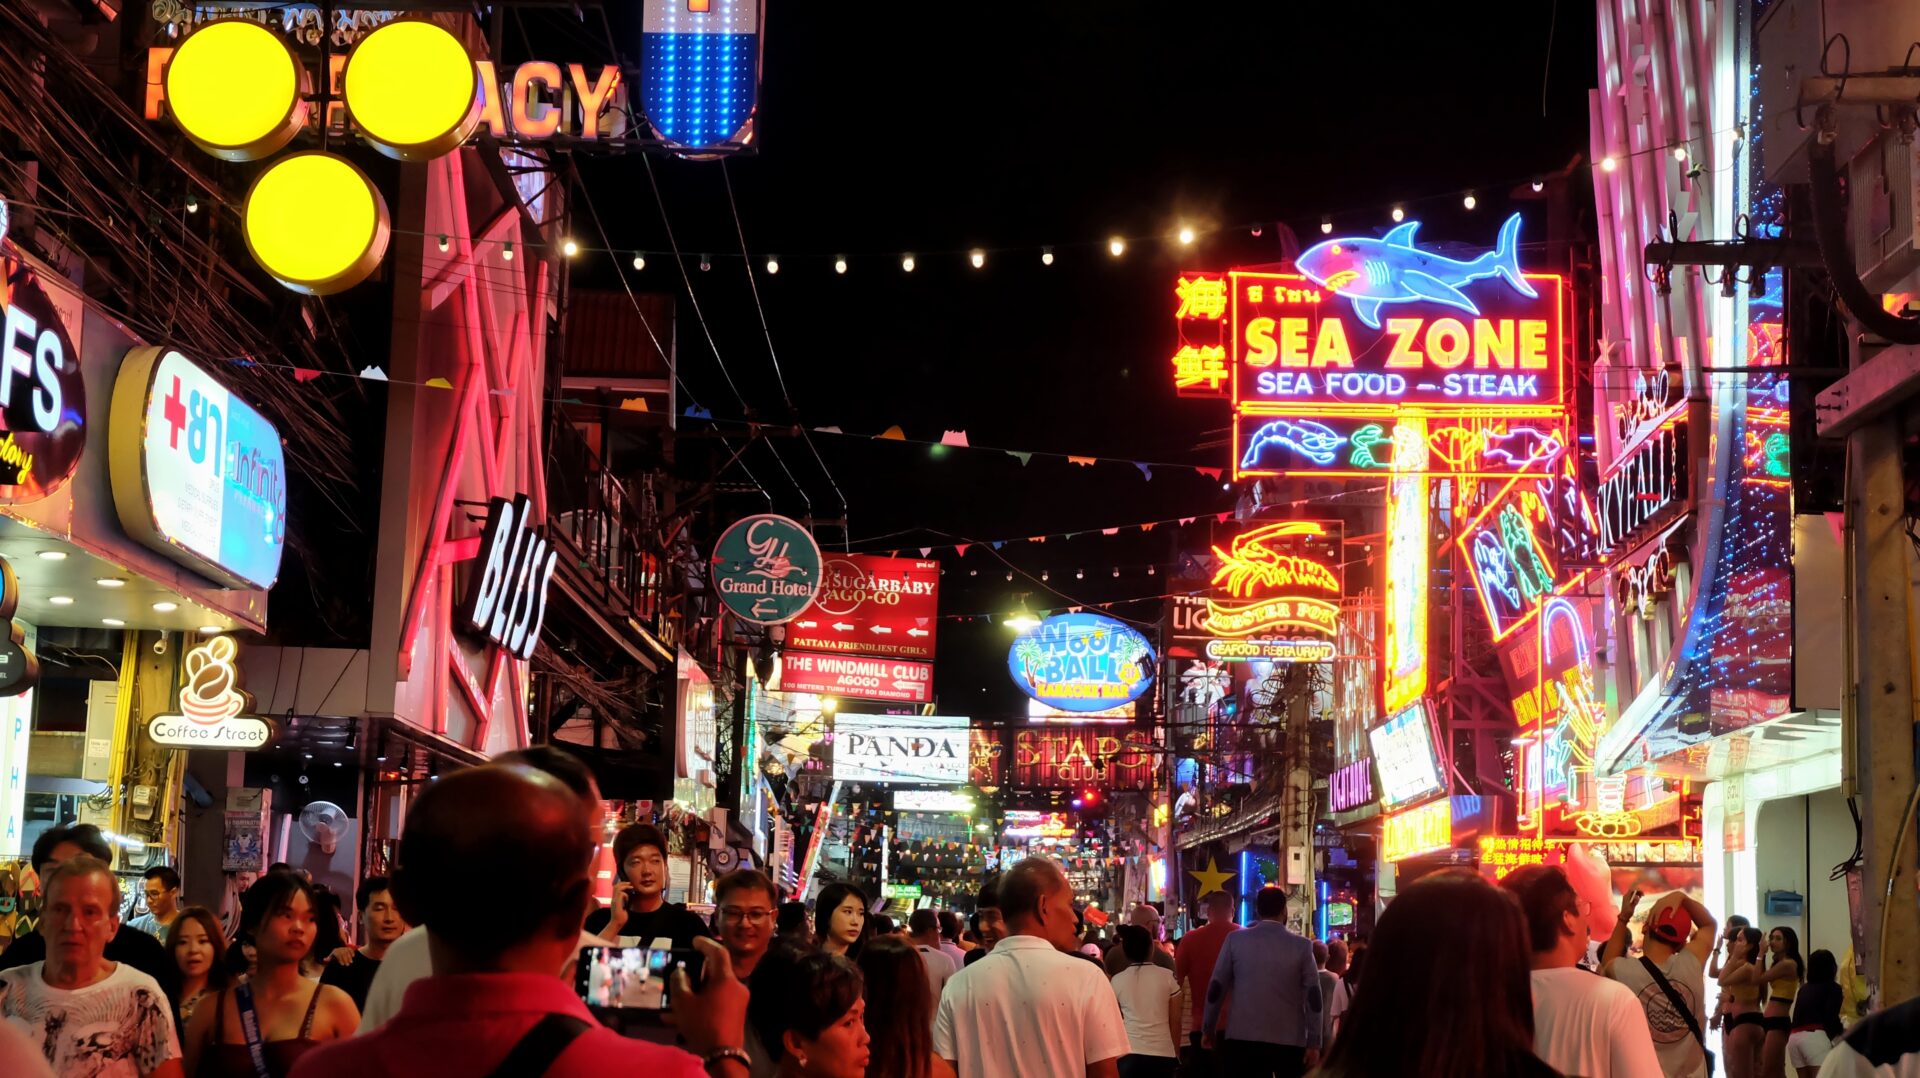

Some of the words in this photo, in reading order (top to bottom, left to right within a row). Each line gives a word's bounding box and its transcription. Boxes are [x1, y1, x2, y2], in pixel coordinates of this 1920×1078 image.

[1245, 317, 1353, 368] SEA
[1384, 318, 1549, 369] ZONE
[1256, 371, 1314, 395] SEA
[1325, 372, 1407, 396] FOOD
[1443, 374, 1538, 397] STEAK
[1596, 430, 1671, 555] SKYFALL
[720, 577, 767, 595] Grand
[771, 580, 813, 597] Hotel
[832, 574, 935, 595] SUGARBABY
[828, 589, 900, 606] AGO-GO
[1212, 602, 1291, 629] LOBSTER
[1296, 602, 1333, 623] POT
[793, 637, 836, 650] PATTAYA
[838, 641, 897, 654] FRIENDLIEST
[899, 645, 928, 656] GIRLS
[1211, 643, 1260, 656] SEAFOOD
[1263, 645, 1331, 658] RESTAURANT
[786, 656, 812, 671] THE
[817, 658, 888, 678] WINDMILL
[893, 664, 929, 681] CLUB
[1043, 654, 1122, 683] BALL
[796, 683, 825, 691] METERS
[827, 685, 845, 693] TURN
[847, 687, 863, 695] LEFT
[878, 690, 911, 699] DIAMOND
[837, 675, 880, 688] AGOGO
[1037, 682, 1097, 698] KARAOKE
[1103, 683, 1130, 698] BAR
[154, 722, 208, 739] Coffee
[214, 725, 264, 741] Street
[848, 733, 957, 758] PANDA
[1058, 766, 1106, 780] CLUB
